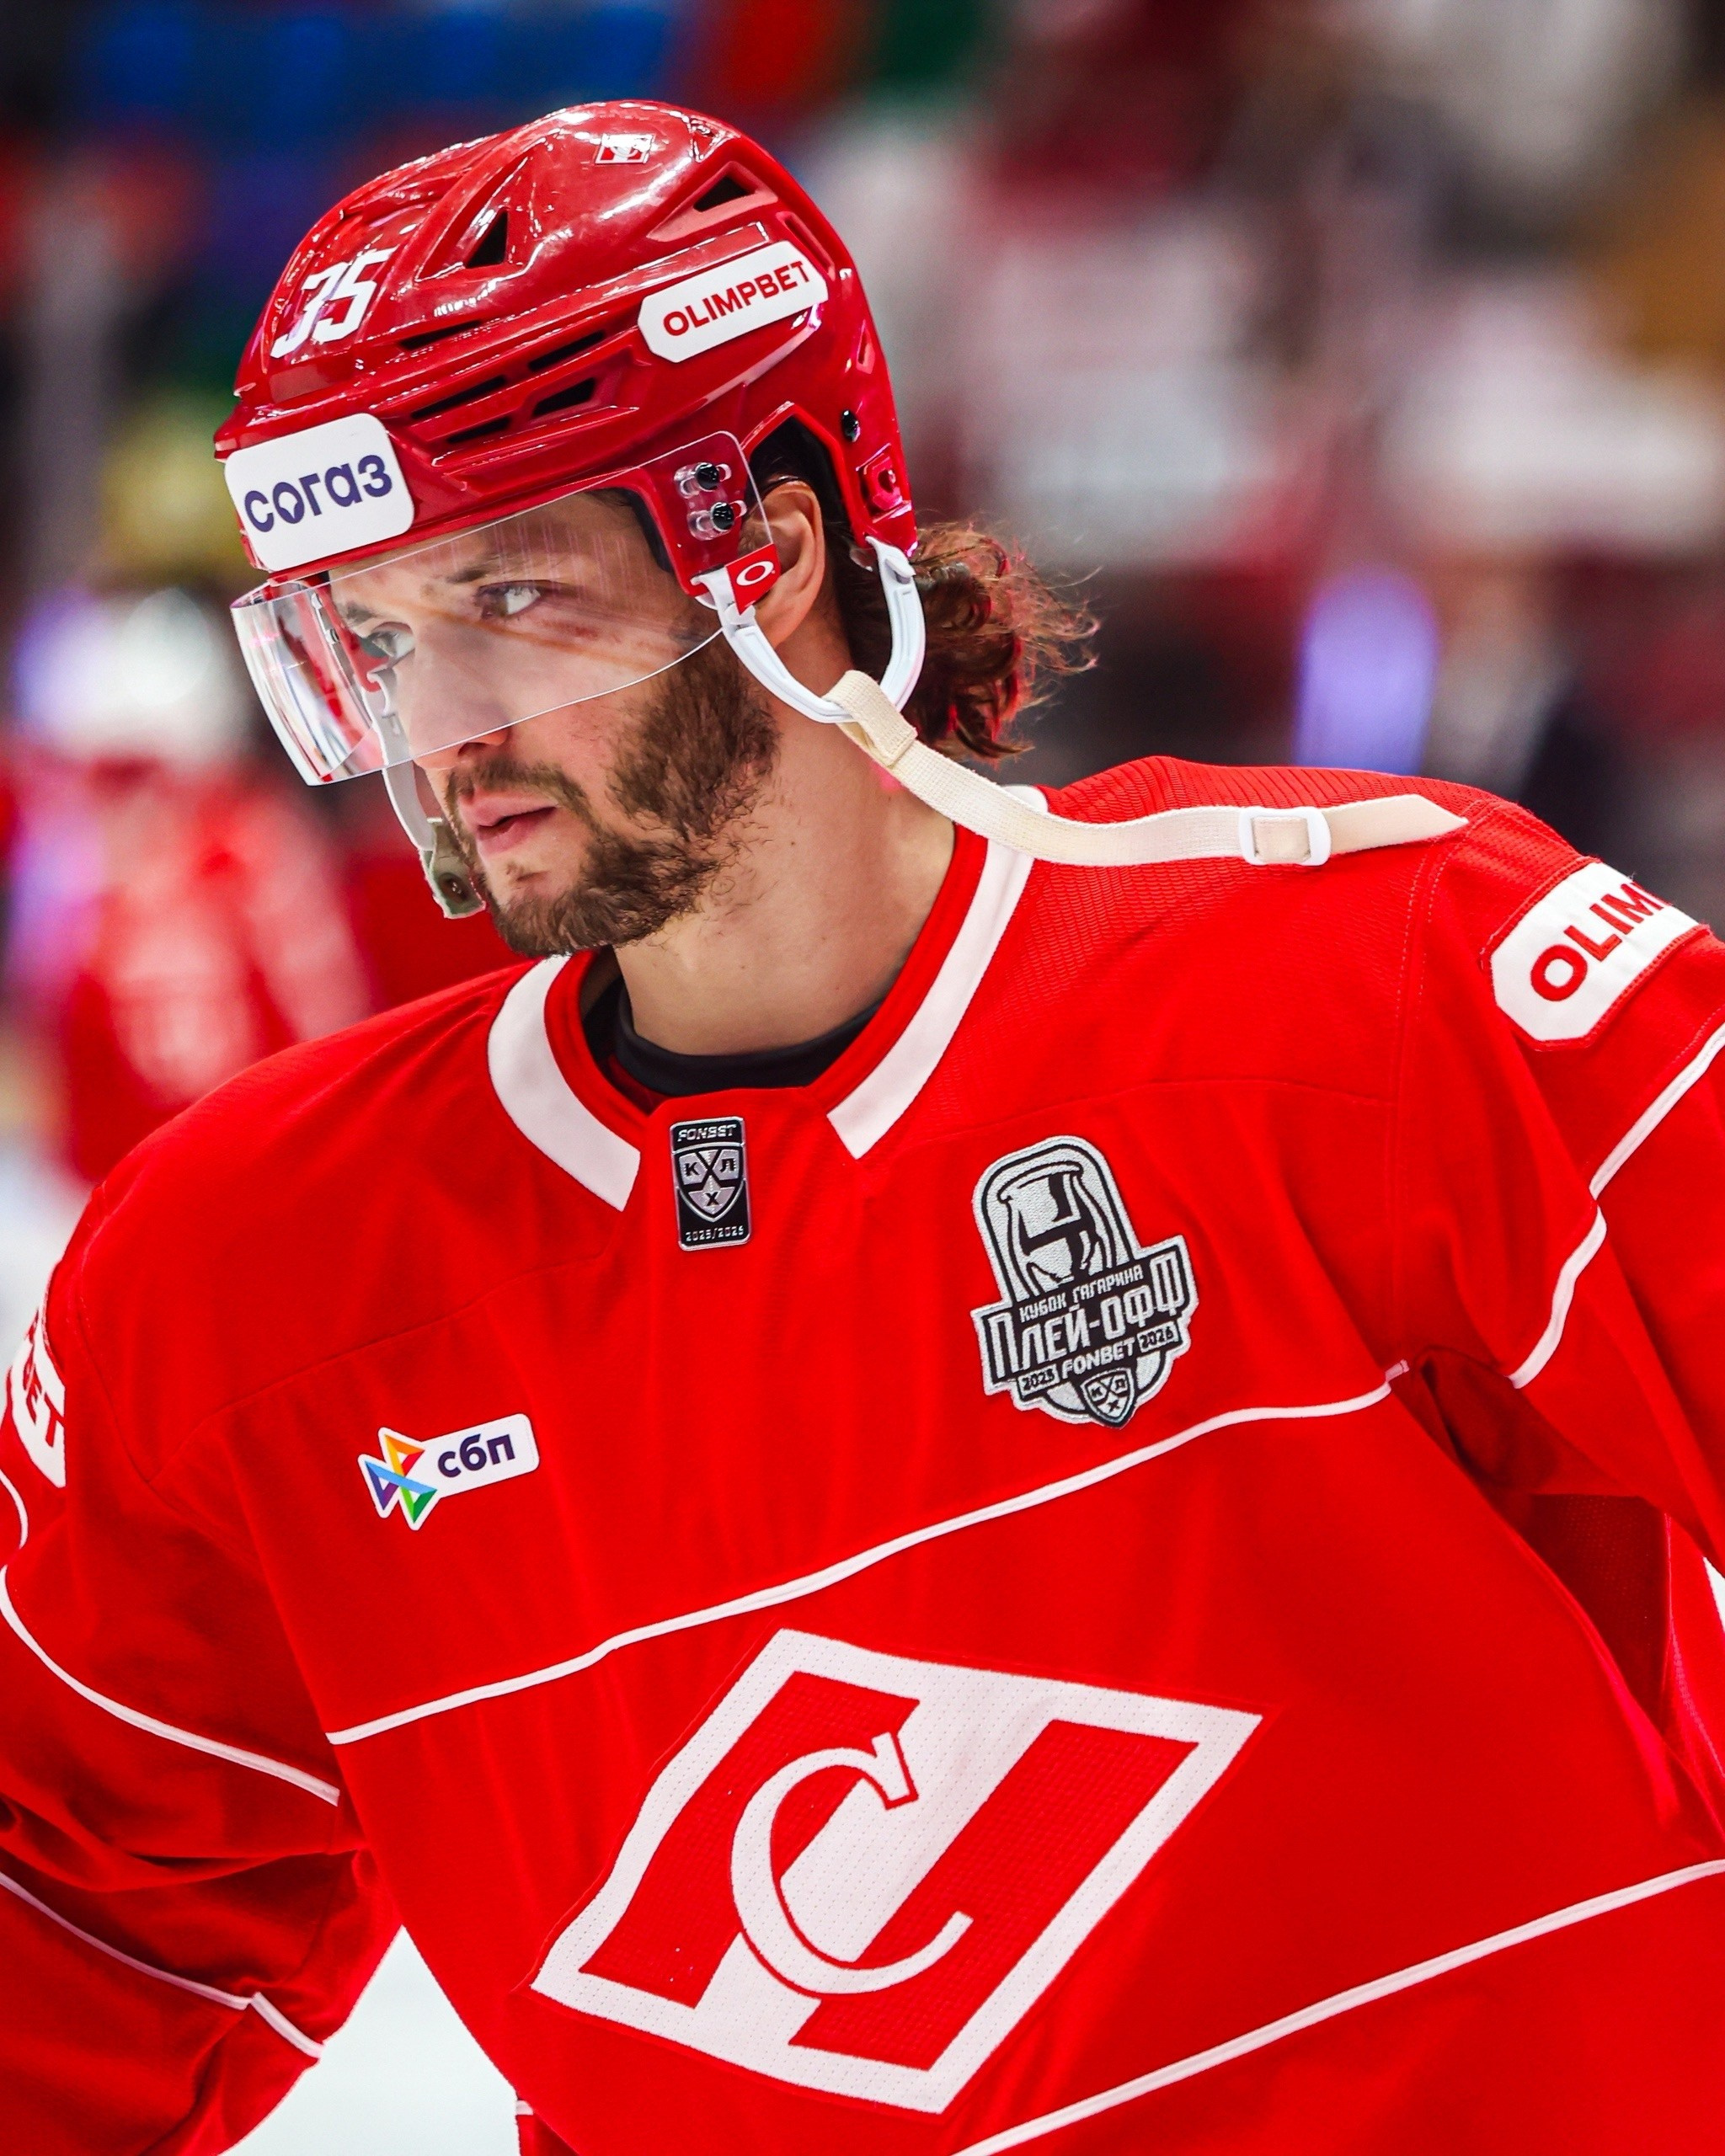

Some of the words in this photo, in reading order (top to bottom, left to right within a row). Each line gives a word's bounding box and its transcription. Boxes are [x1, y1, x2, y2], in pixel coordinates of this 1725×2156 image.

[270, 246, 400, 359] 35
[662, 260, 810, 336] OLIMPBET
[244, 454, 393, 533] согаз
[1530, 881, 1668, 1002] OLIM
[677, 1123, 737, 1142] FONBET
[987, 1254, 1186, 1380] ПЛЕЙ-ОФФ
[1019, 1294, 1068, 1323] КУБОК
[1072, 1264, 1145, 1305] ГАГАРИНА
[1062, 1337, 1135, 1380] FONBET
[437, 1433, 515, 1478] сбп
